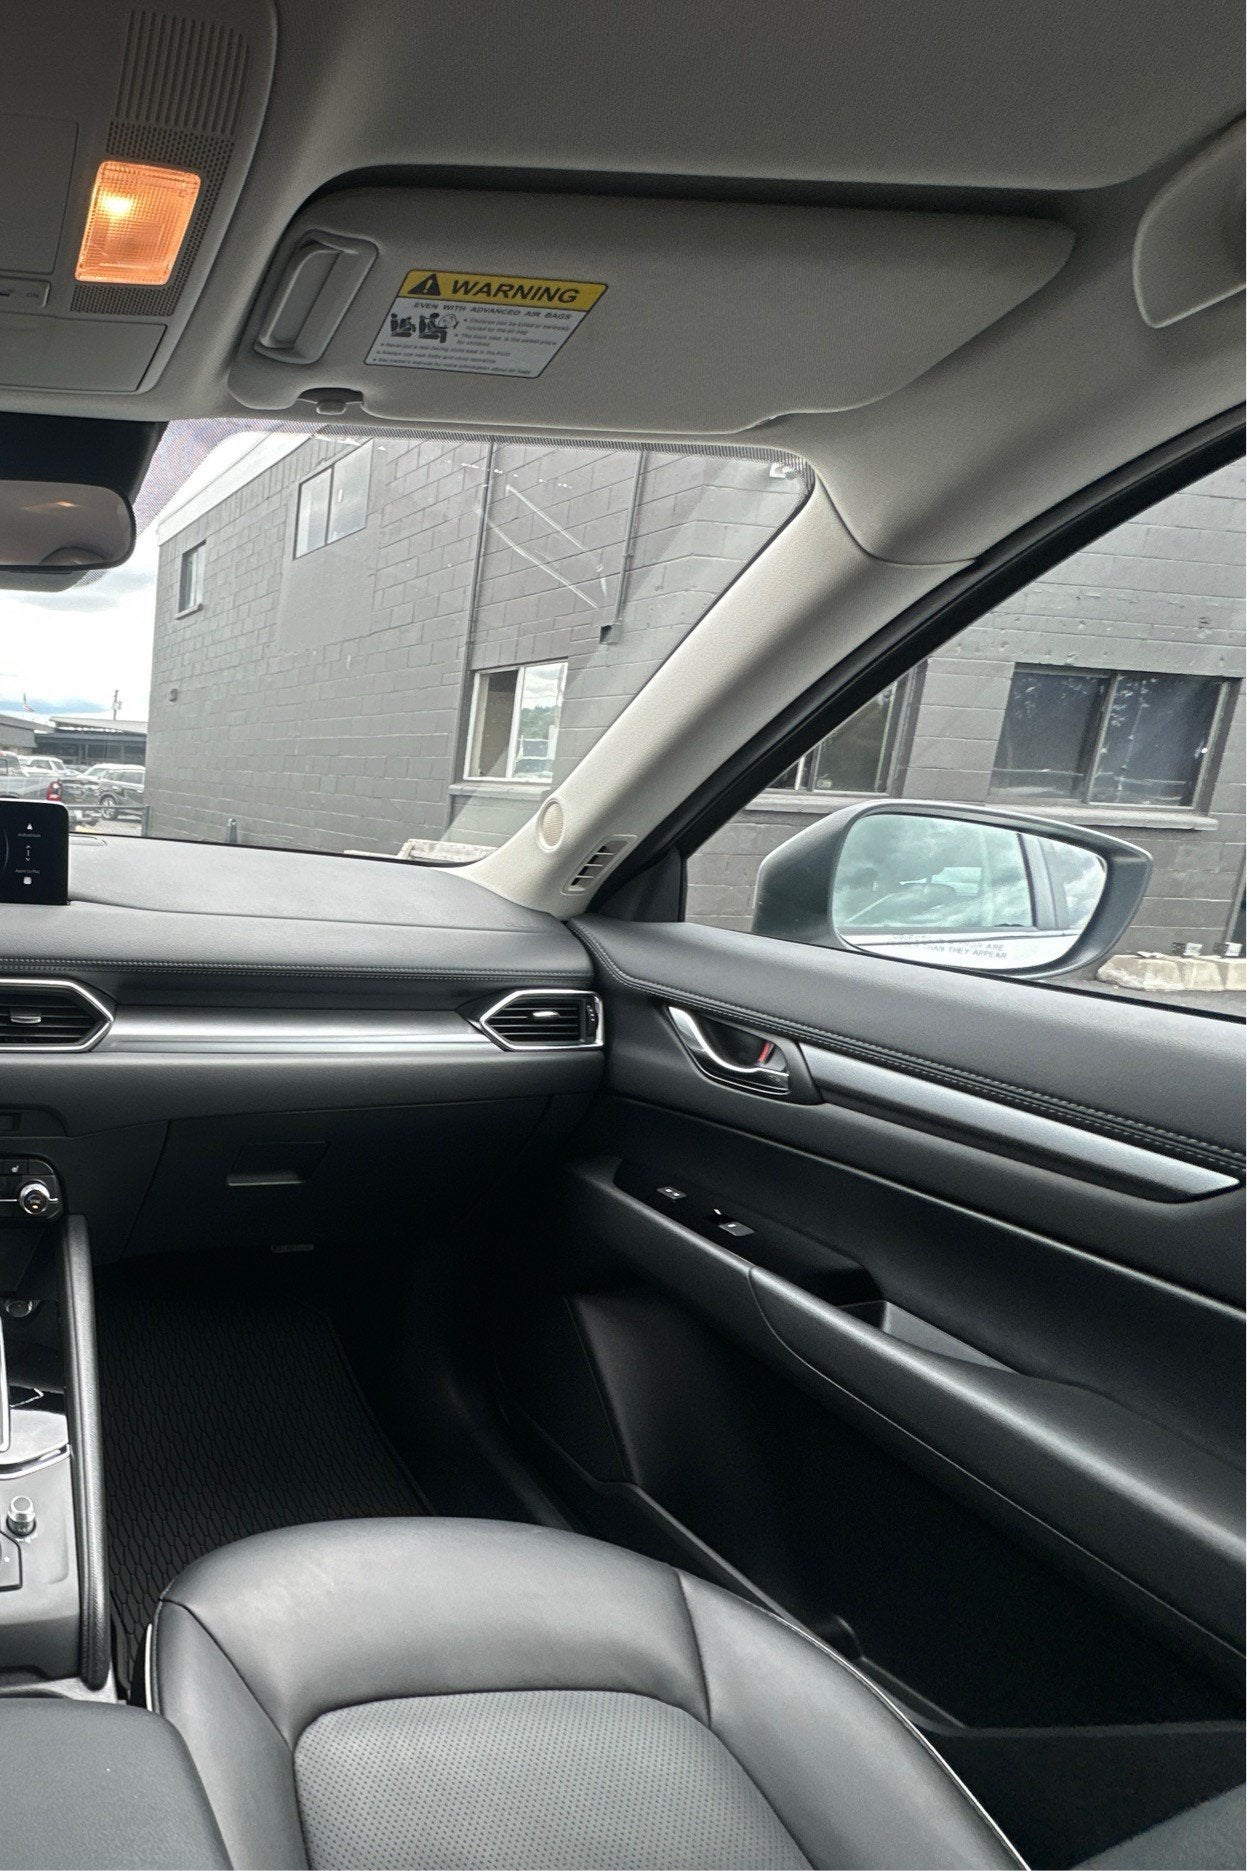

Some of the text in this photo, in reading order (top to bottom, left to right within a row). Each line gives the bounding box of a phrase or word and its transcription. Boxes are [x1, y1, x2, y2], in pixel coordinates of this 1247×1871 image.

[447, 280, 583, 303] WARNING
[469, 306, 521, 315] ADVANCED
[948, 946, 970, 954] THEY
[972, 949, 1007, 959] APPEAR
[985, 944, 1005, 952] ARE
